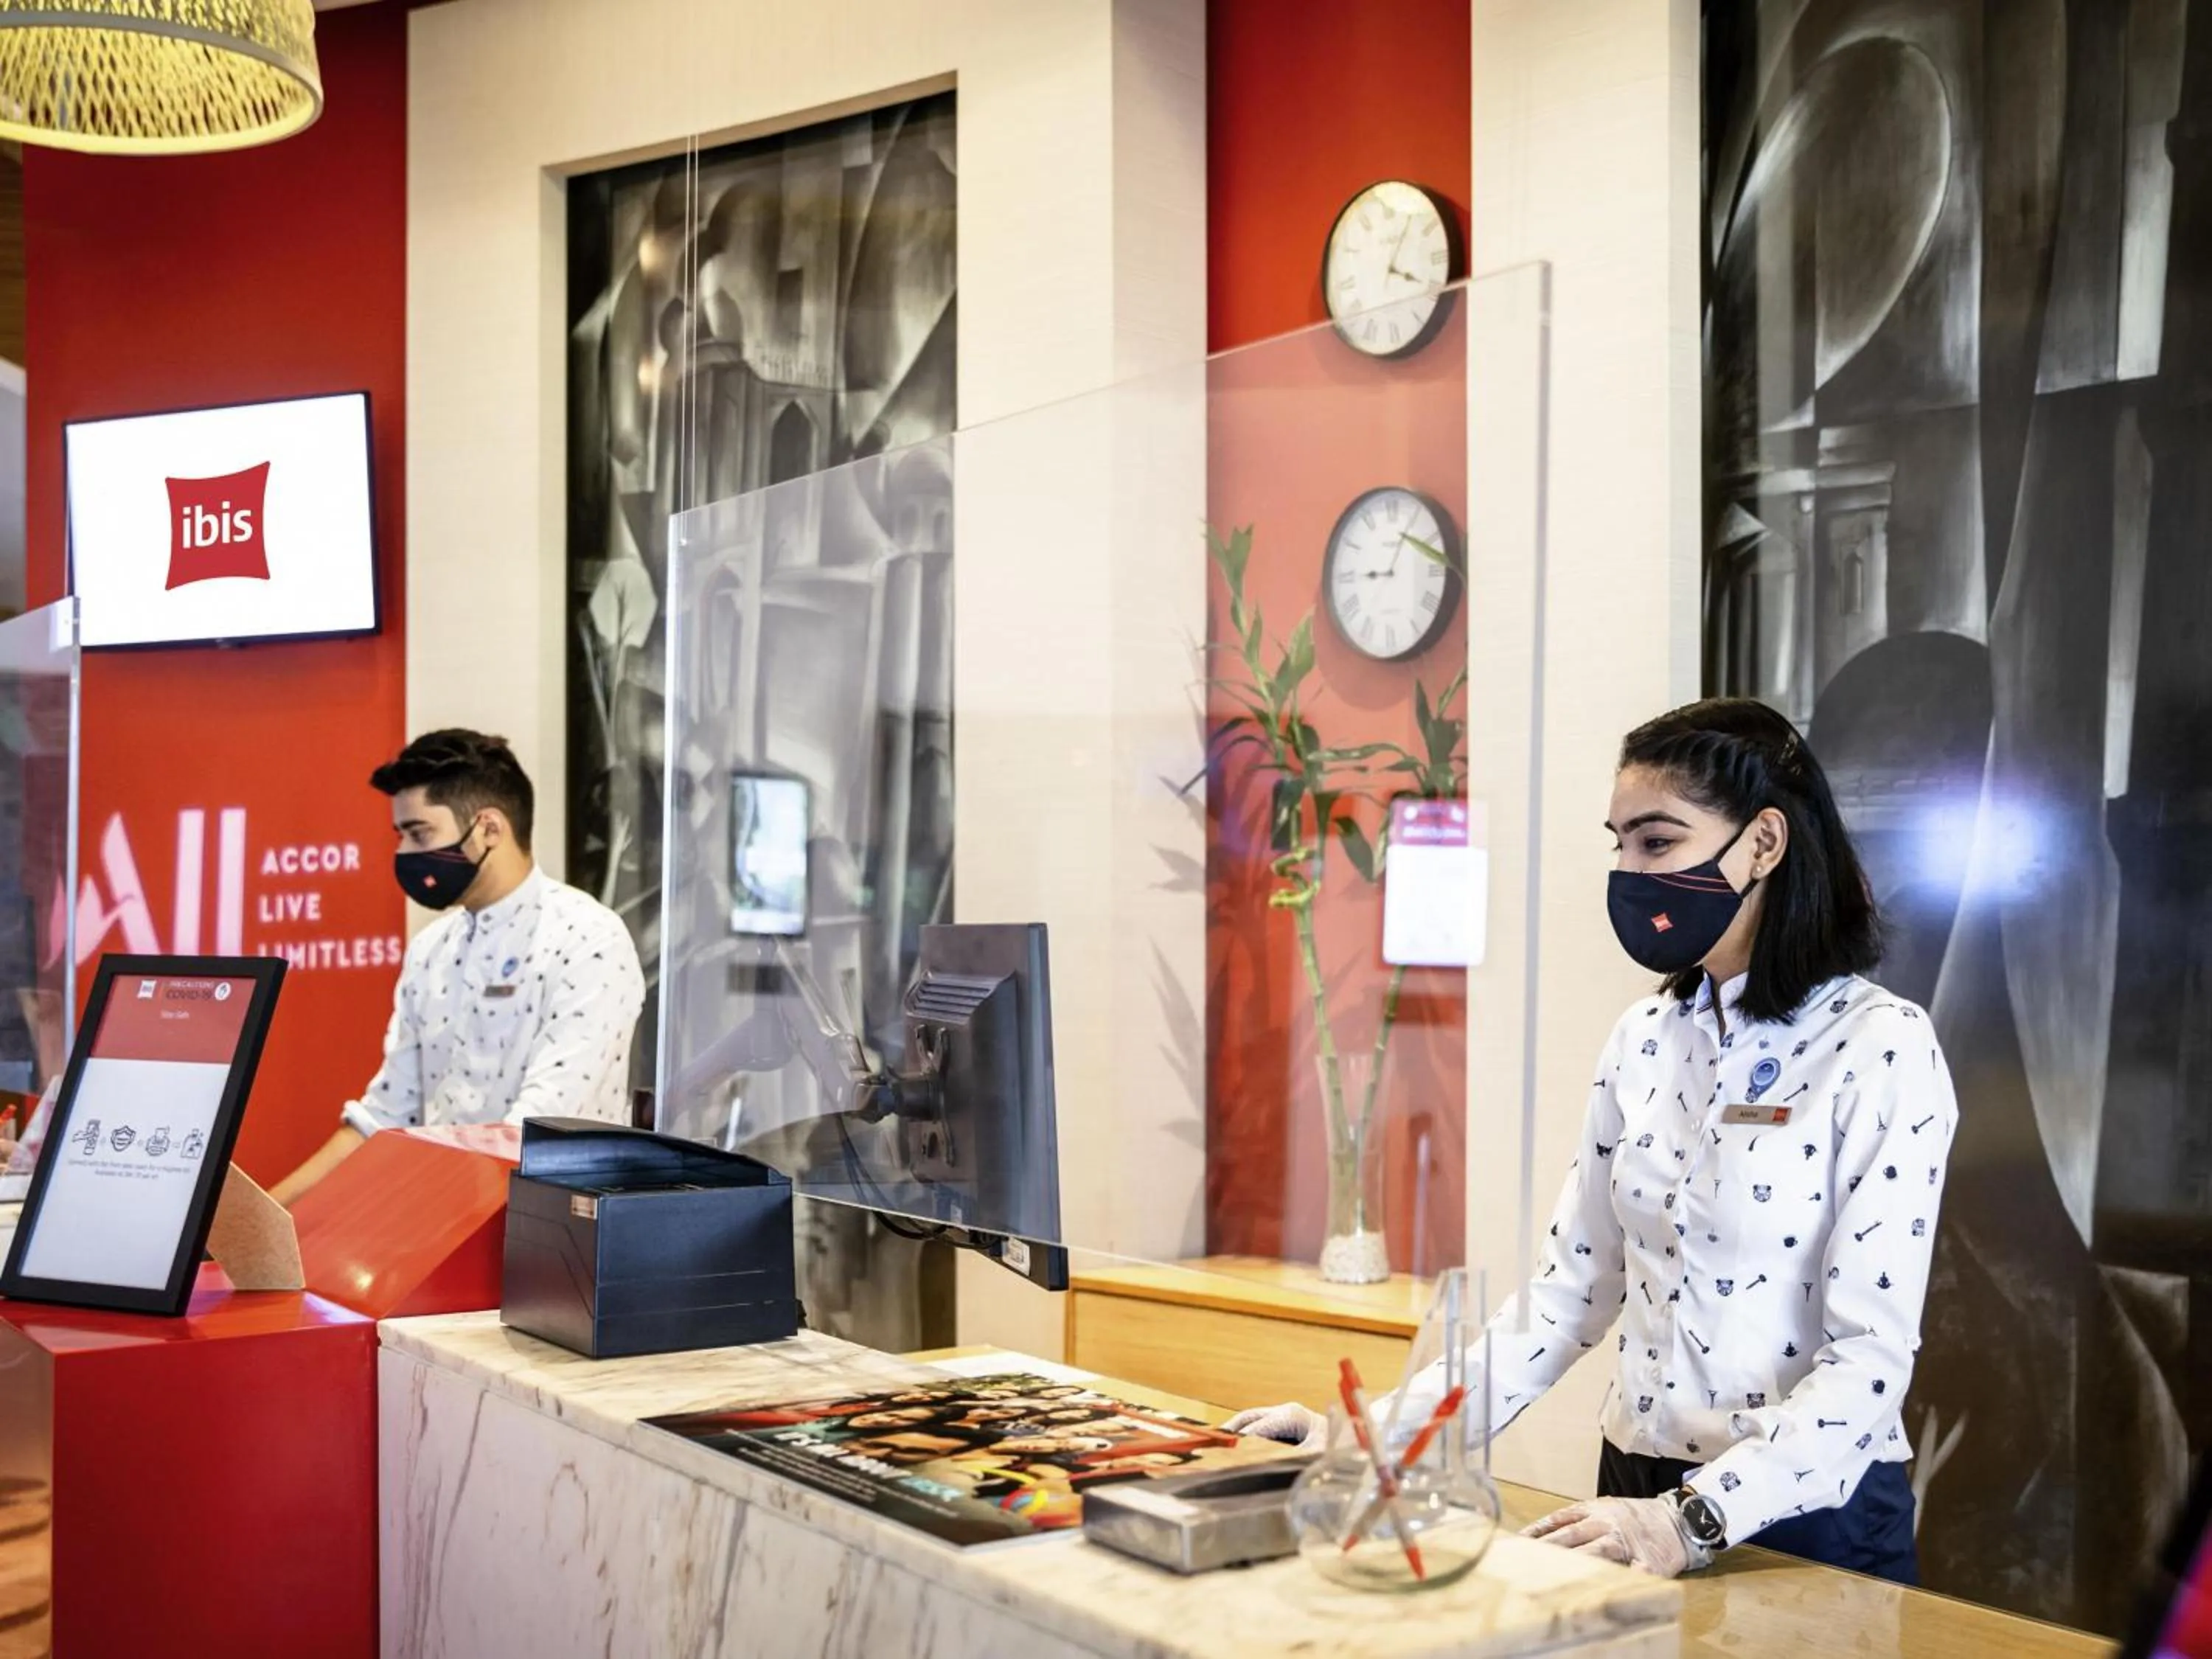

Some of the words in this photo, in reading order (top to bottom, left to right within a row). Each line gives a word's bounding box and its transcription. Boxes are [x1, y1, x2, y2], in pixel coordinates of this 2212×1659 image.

[182, 501, 253, 549] ibis
[260, 844, 361, 875] ACCOR
[258, 892, 322, 923] LIVE
[166, 989, 212, 1001] COVID-19
